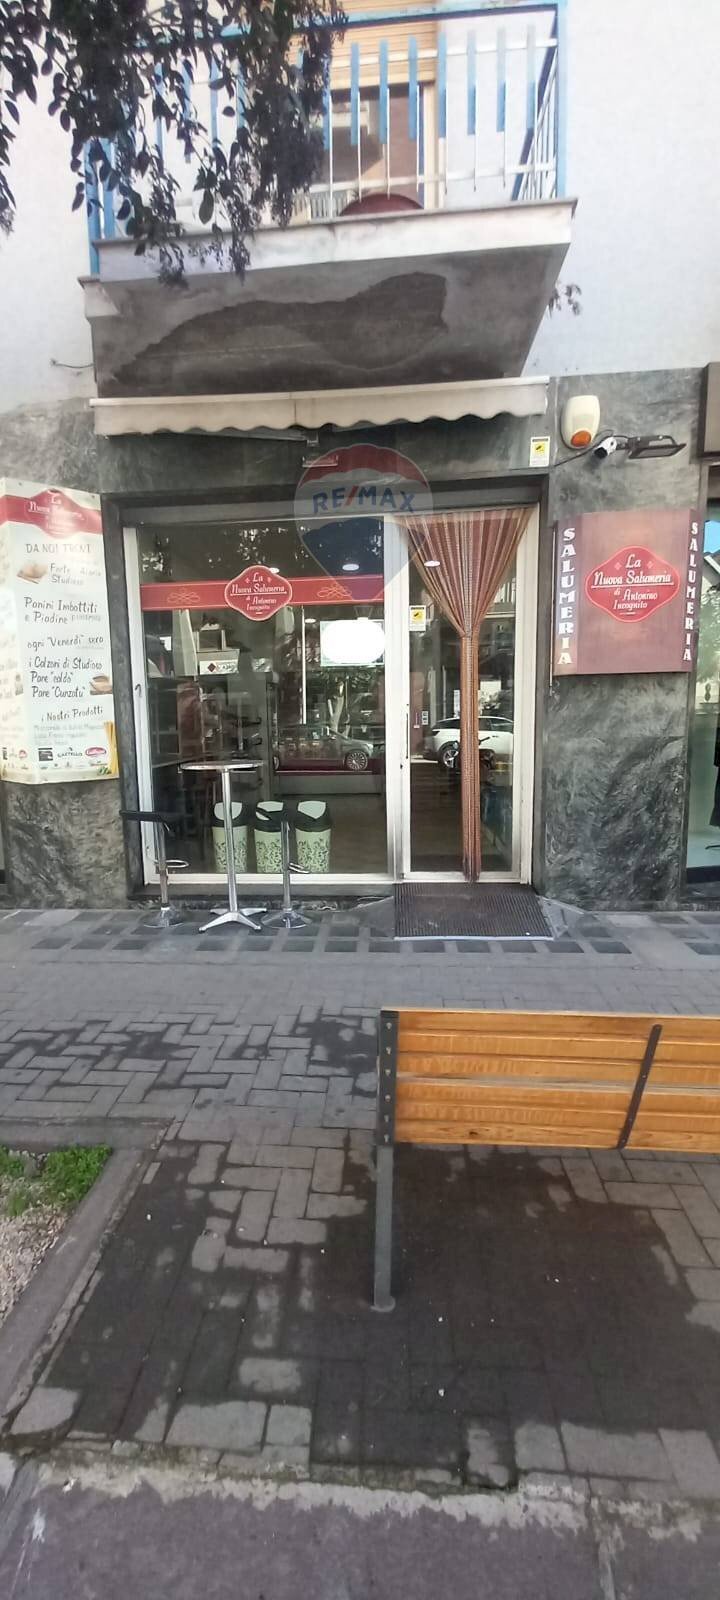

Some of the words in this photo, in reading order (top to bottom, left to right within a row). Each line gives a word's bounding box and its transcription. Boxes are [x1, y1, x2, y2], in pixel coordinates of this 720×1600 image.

[625, 554, 641, 568] La
[594, 571, 623, 586] Nuova
[626, 570, 671, 584] Salumeria
[557, 527, 577, 665] SALUMERIA
[623, 588, 658, 602] Antonino
[683, 521, 698, 661] SALUMERIA
[613, 600, 648, 611] Incognito
